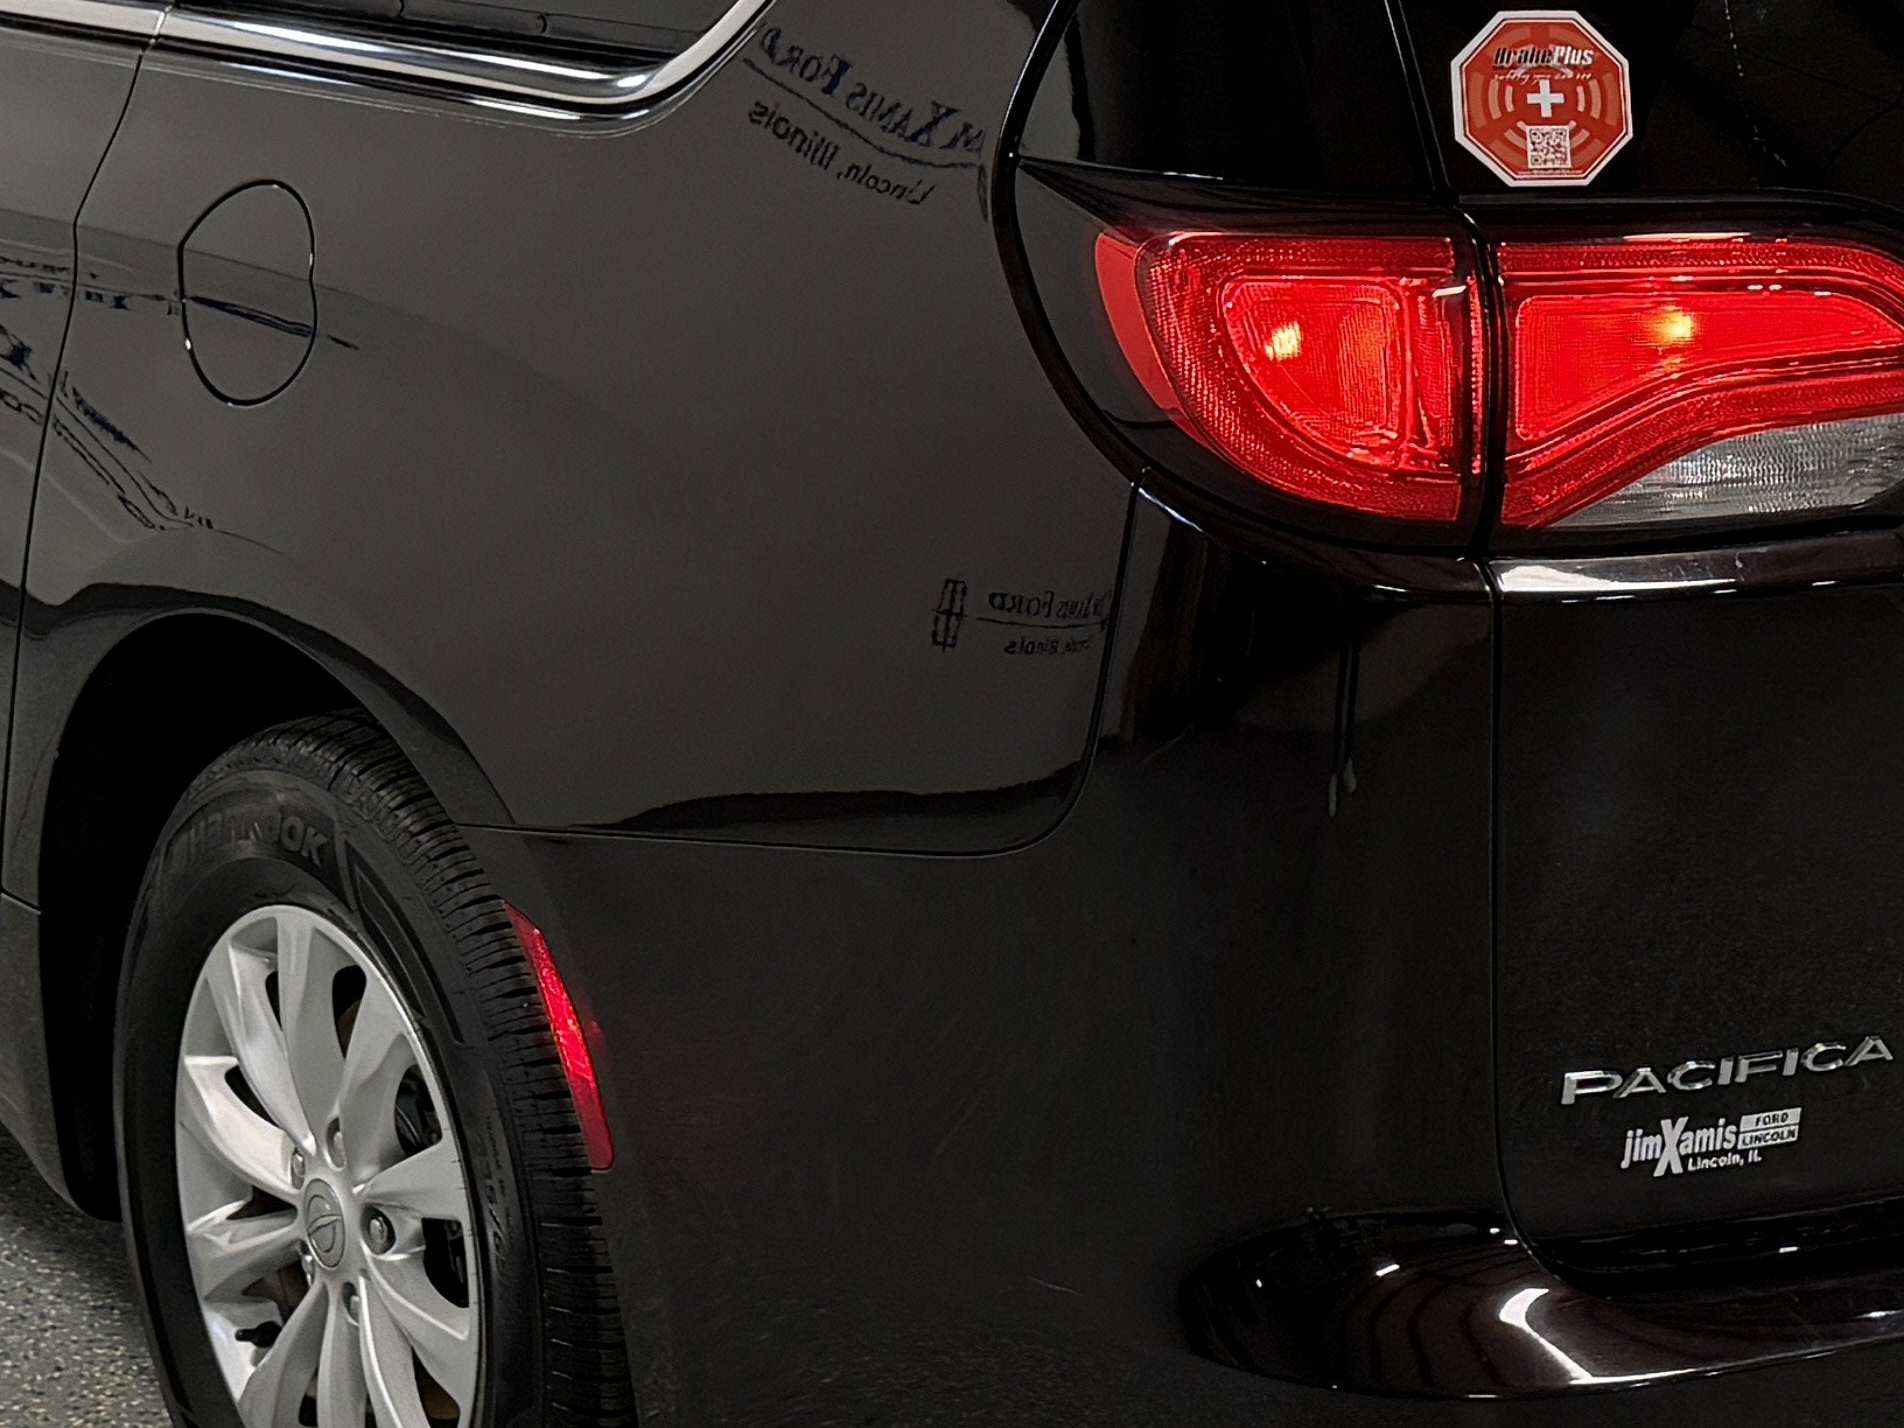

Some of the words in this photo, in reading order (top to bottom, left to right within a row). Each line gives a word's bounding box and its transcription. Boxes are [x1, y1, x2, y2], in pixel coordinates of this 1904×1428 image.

[1560, 1034, 1895, 1106] PACIFICA
[1754, 1111, 1789, 1128] FORD
[1748, 1148, 1763, 1163] IL
